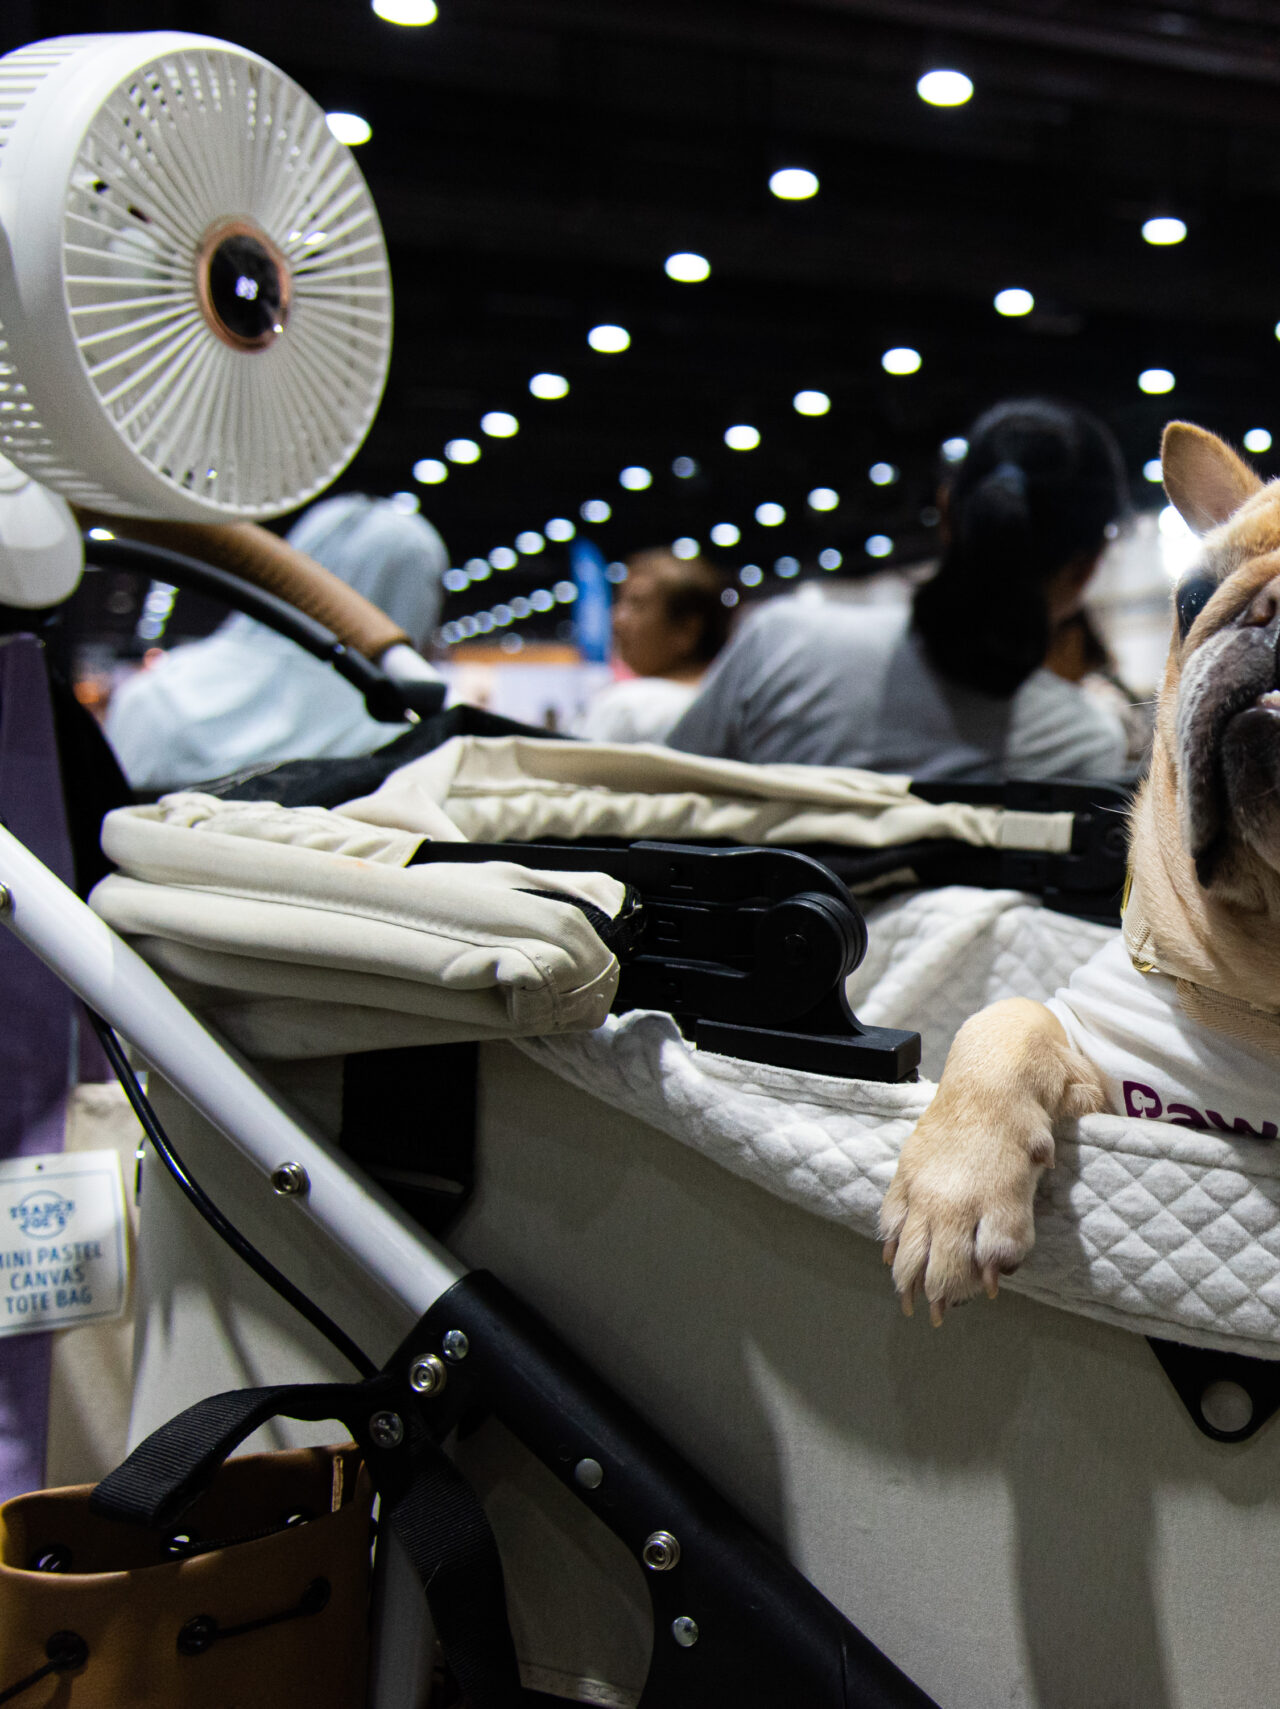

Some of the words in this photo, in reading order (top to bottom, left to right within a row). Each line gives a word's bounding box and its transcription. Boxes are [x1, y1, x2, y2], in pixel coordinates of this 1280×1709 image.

[37, 1242, 102, 1264] PASTEL
[10, 1266, 86, 1291] CANVAS
[6, 1294, 49, 1314] TOTE
[56, 1287, 92, 1308] BAG
